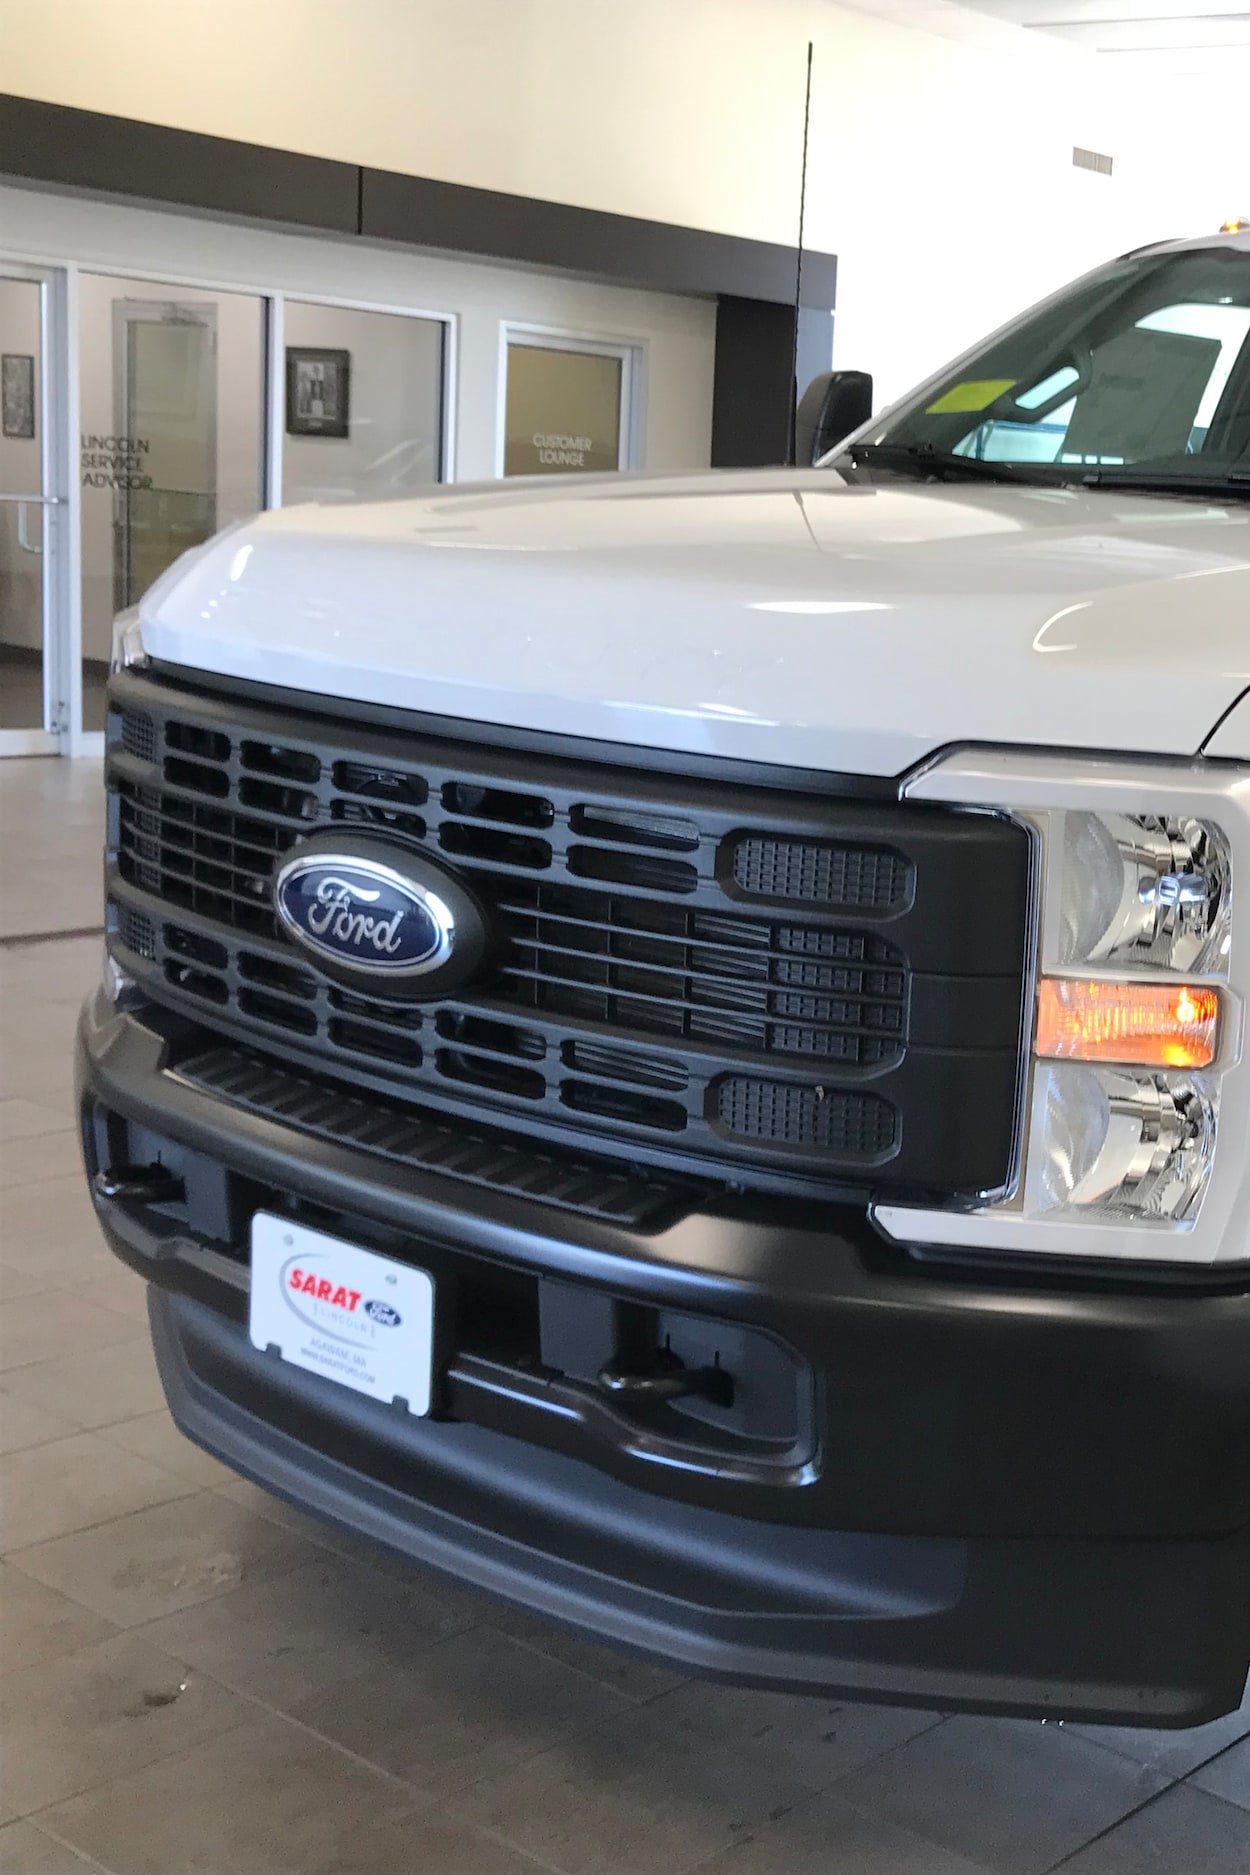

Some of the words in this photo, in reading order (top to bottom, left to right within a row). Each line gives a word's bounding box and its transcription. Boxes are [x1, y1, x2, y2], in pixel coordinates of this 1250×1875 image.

[80, 434, 150, 454] LINCOLN
[533, 433, 592, 452] CUSTOMER
[81, 453, 143, 472] SERVICE
[540, 448, 585, 467] LOUNGE
[82, 472, 153, 490] ADVISOR
[308, 877, 404, 953] Ford
[289, 1269, 362, 1312] SARAT
